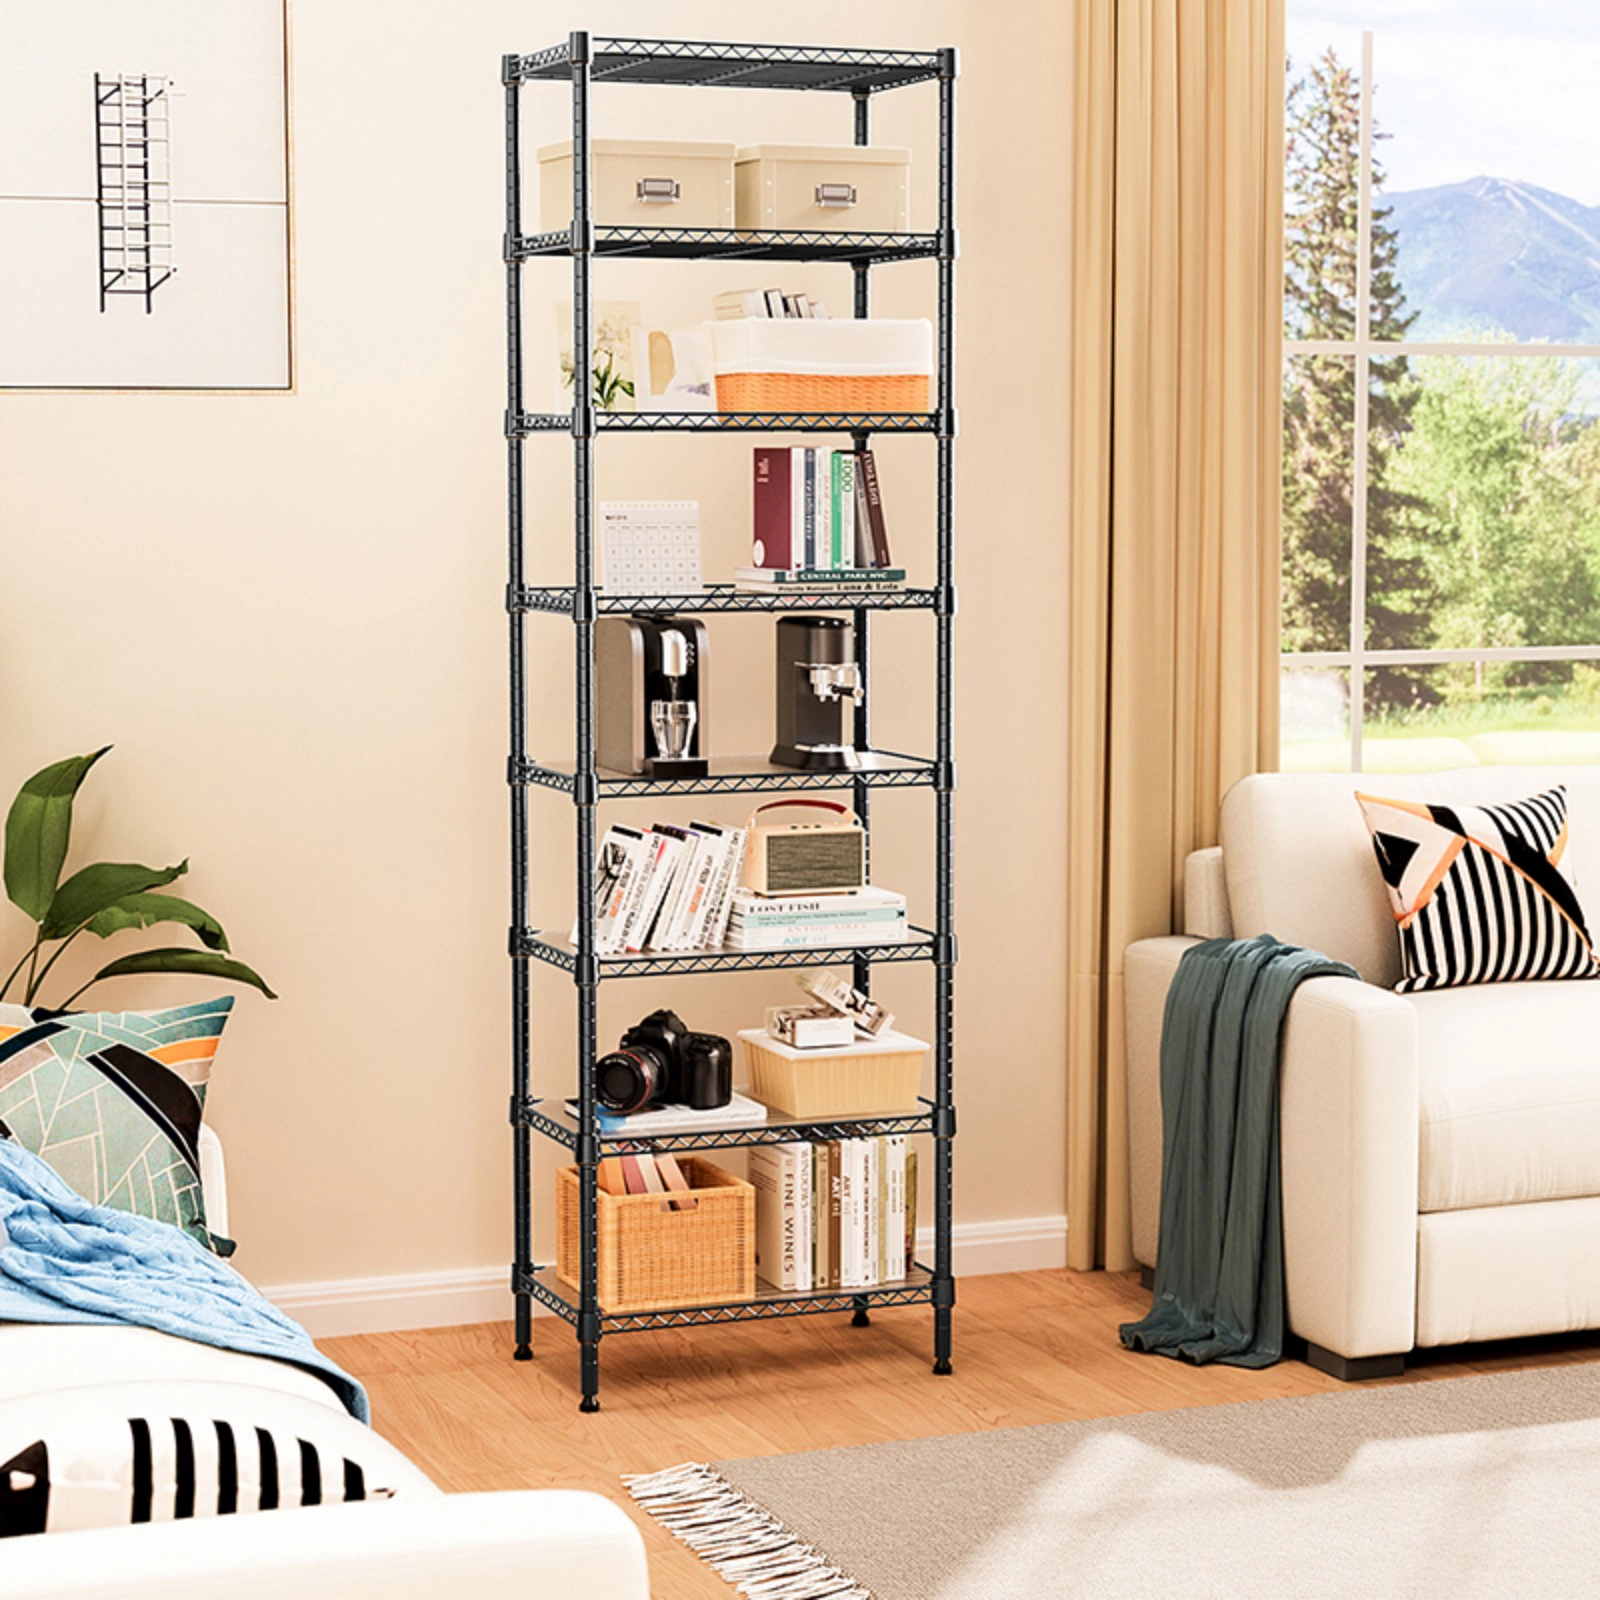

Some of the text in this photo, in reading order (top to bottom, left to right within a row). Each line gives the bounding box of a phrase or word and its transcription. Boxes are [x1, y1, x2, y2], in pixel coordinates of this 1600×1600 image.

[800, 571, 888, 580] CENTRAL PARK NYC
[863, 583, 873, 591] &
[876, 582, 899, 590] Lola
[749, 902, 820, 913] LOST FISH
[783, 936, 808, 944] ART
[831, 1175, 840, 1199] ART
[843, 1175, 851, 1198] ART
[784, 1173, 795, 1273] FINE WINES
